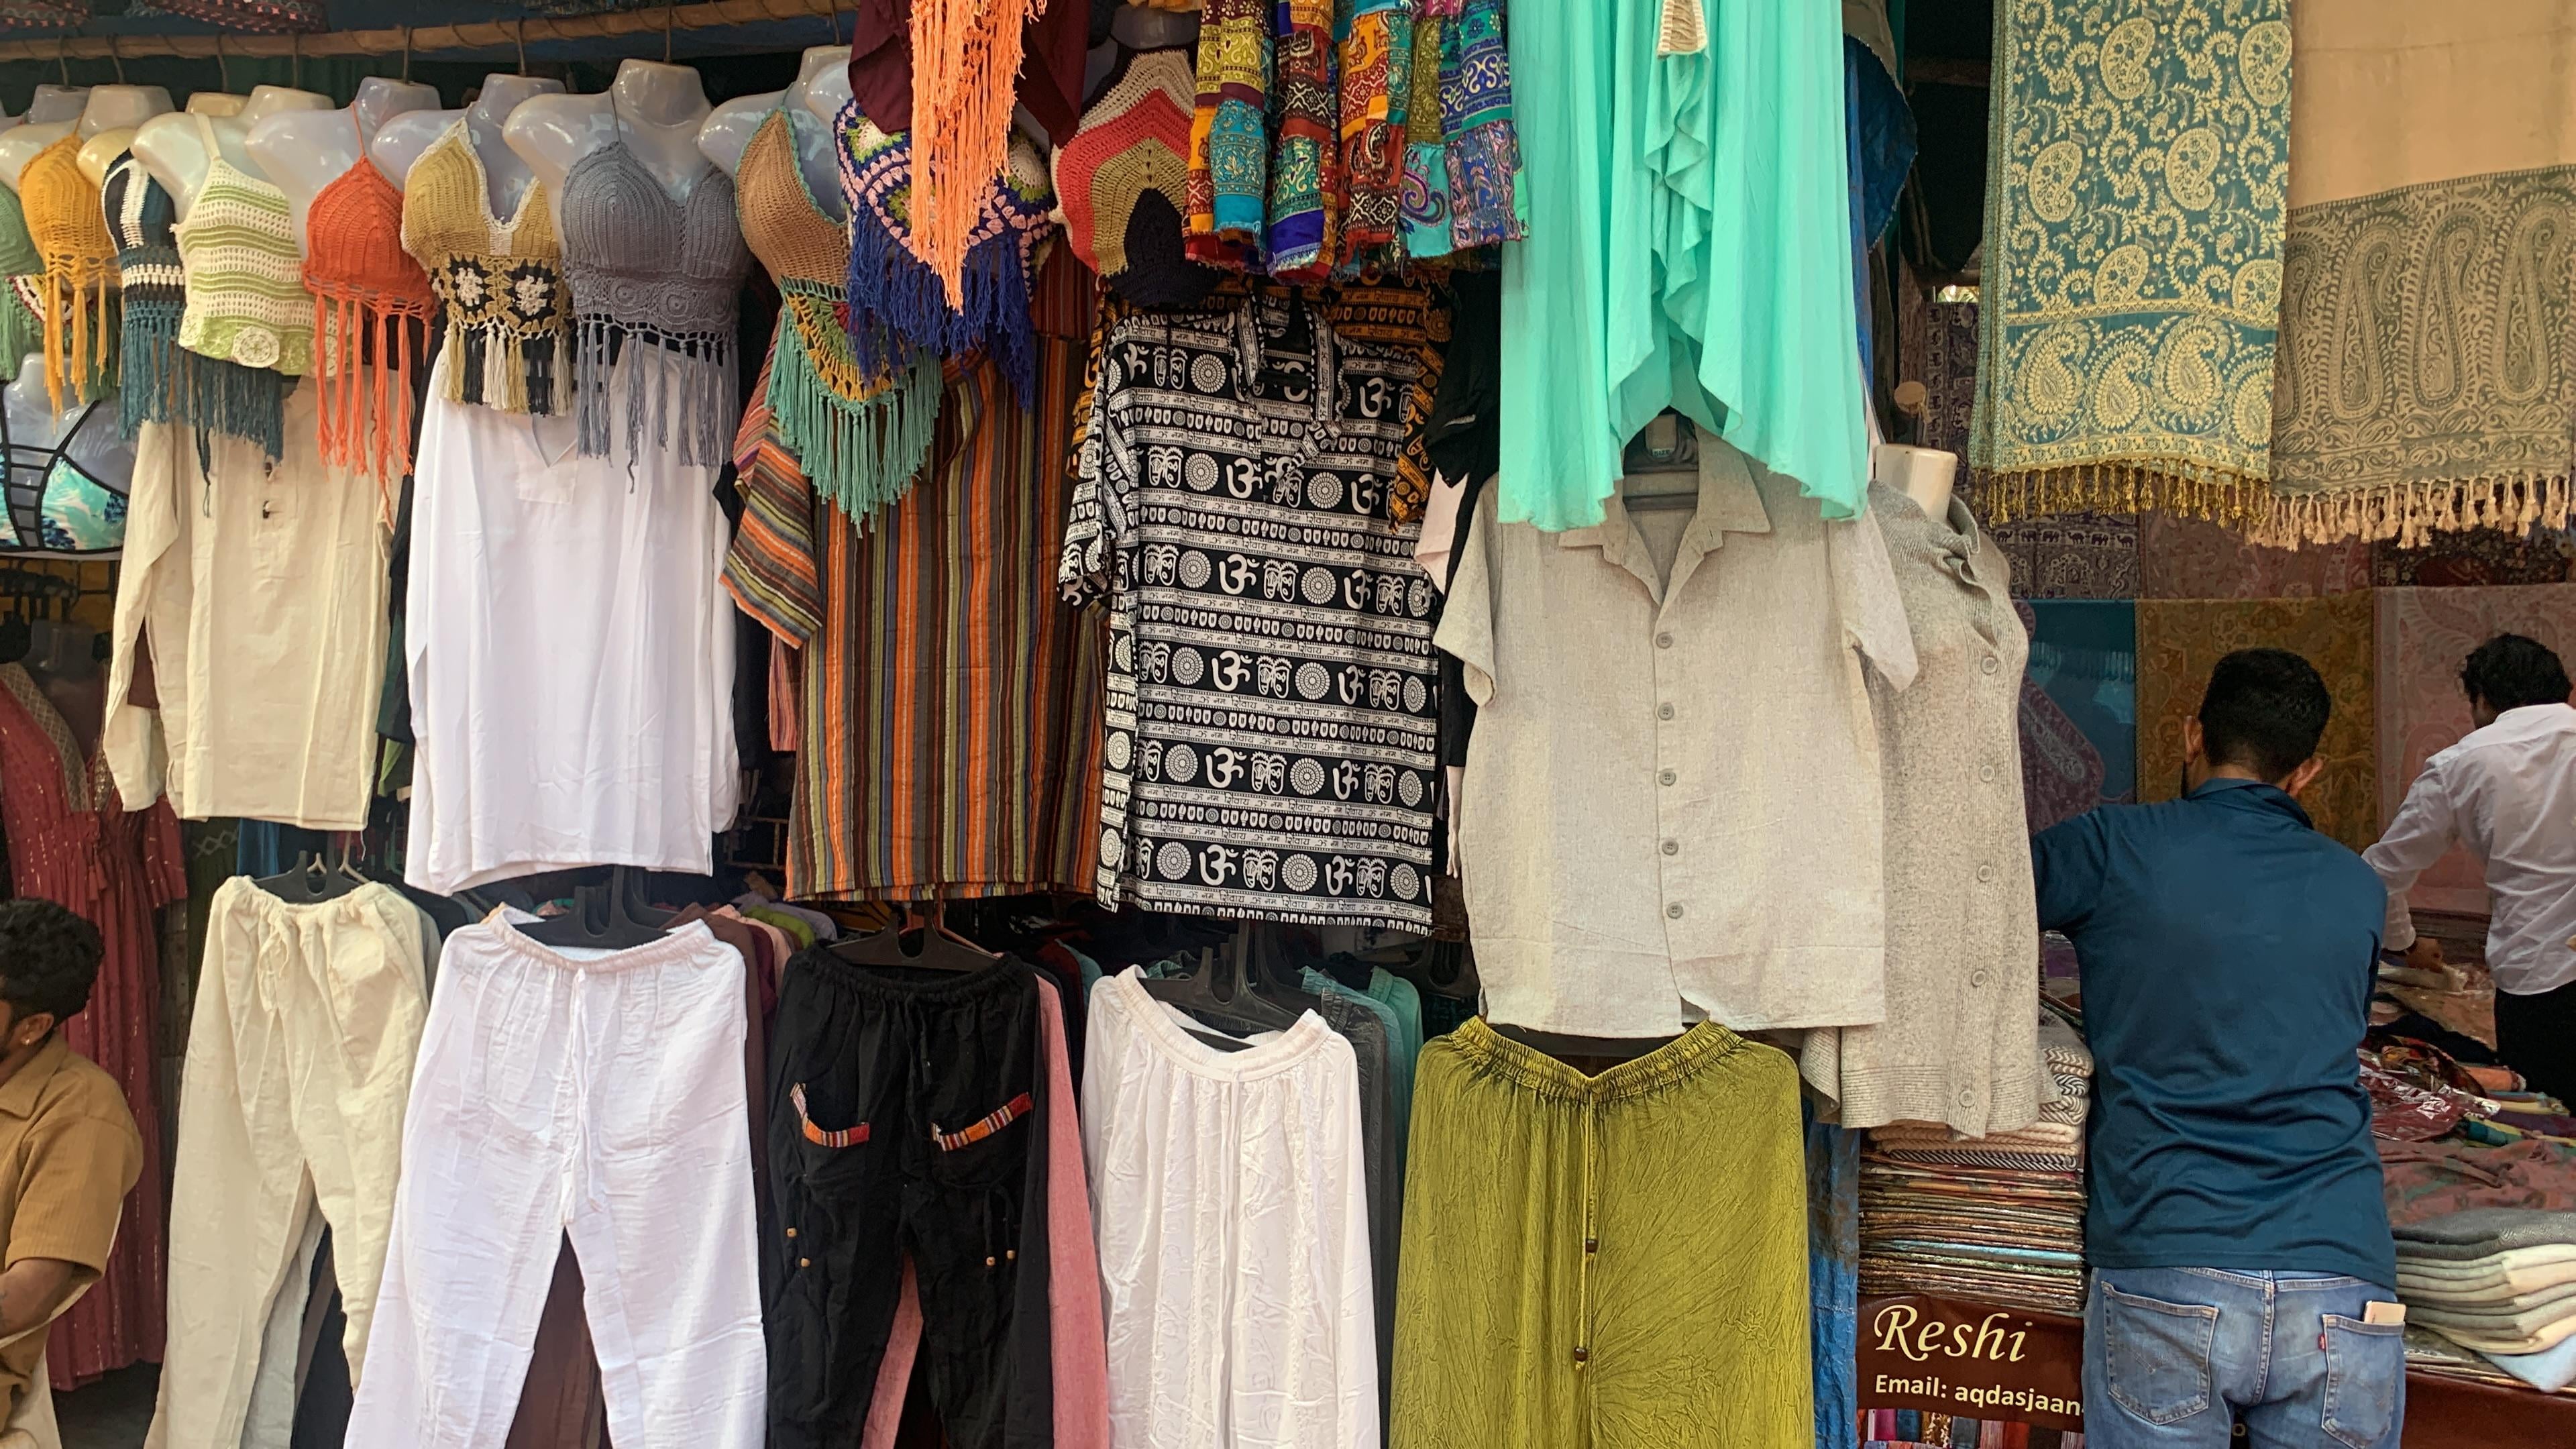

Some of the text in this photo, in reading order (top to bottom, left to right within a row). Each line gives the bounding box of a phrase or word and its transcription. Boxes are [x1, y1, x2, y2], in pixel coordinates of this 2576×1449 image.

[1360, 378, 1396, 418] ॐ
[1226, 458, 1261, 499] ॐ
[1352, 473, 1383, 514] ॐ
[1220, 553, 1373, 610] ॐ ॐ
[1212, 650, 1365, 705] ॐ ॐ
[1206, 747, 1360, 800] ॐ ॐ
[1199, 845, 1354, 896] ॐ ॐ
[1874, 1304, 2033, 1362] Reshi
[1875, 1374, 2084, 1416] Email: aqdasjaan
